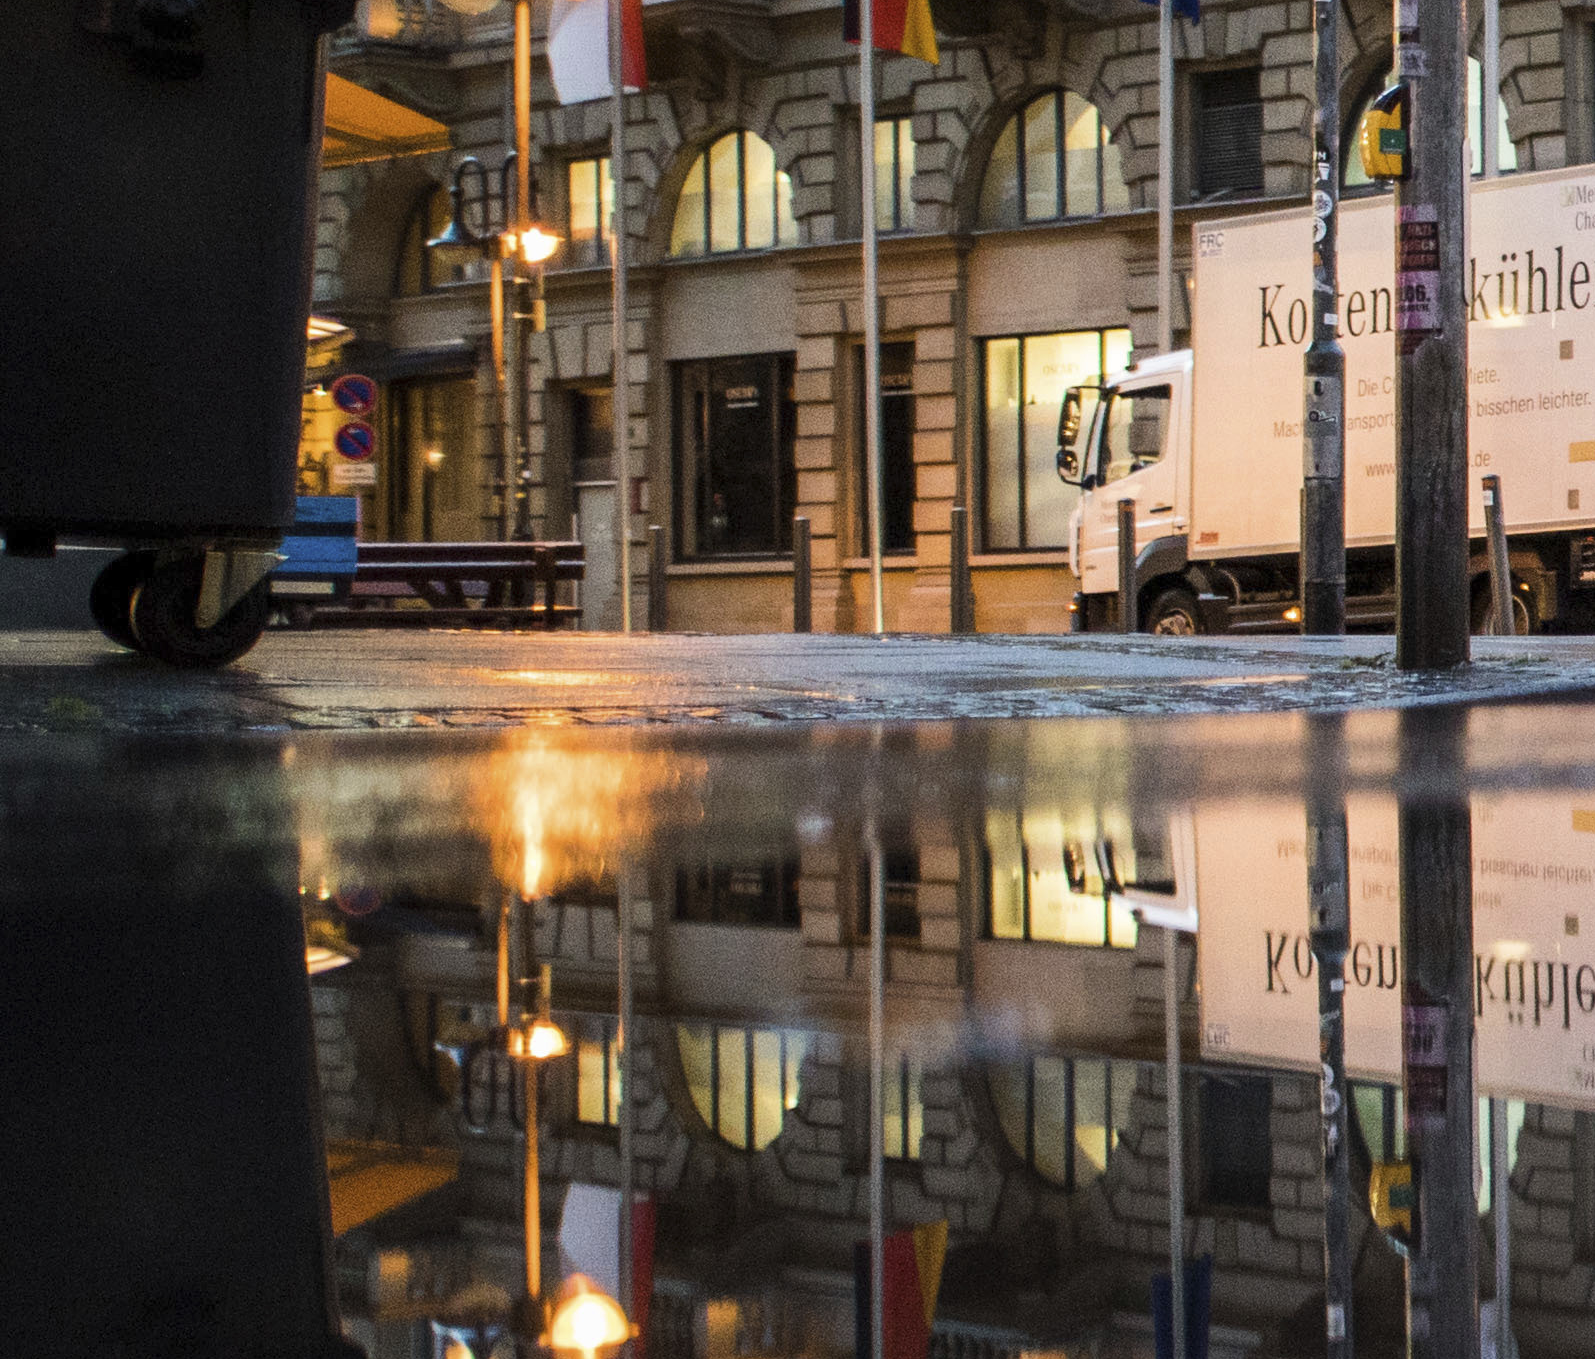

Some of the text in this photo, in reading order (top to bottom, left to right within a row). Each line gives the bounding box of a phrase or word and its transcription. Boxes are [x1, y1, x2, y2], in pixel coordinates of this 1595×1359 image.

[1358, 377, 1379, 398] Die
[1476, 397, 1535, 418] bisschen
[1538, 390, 1592, 411] leichter.
